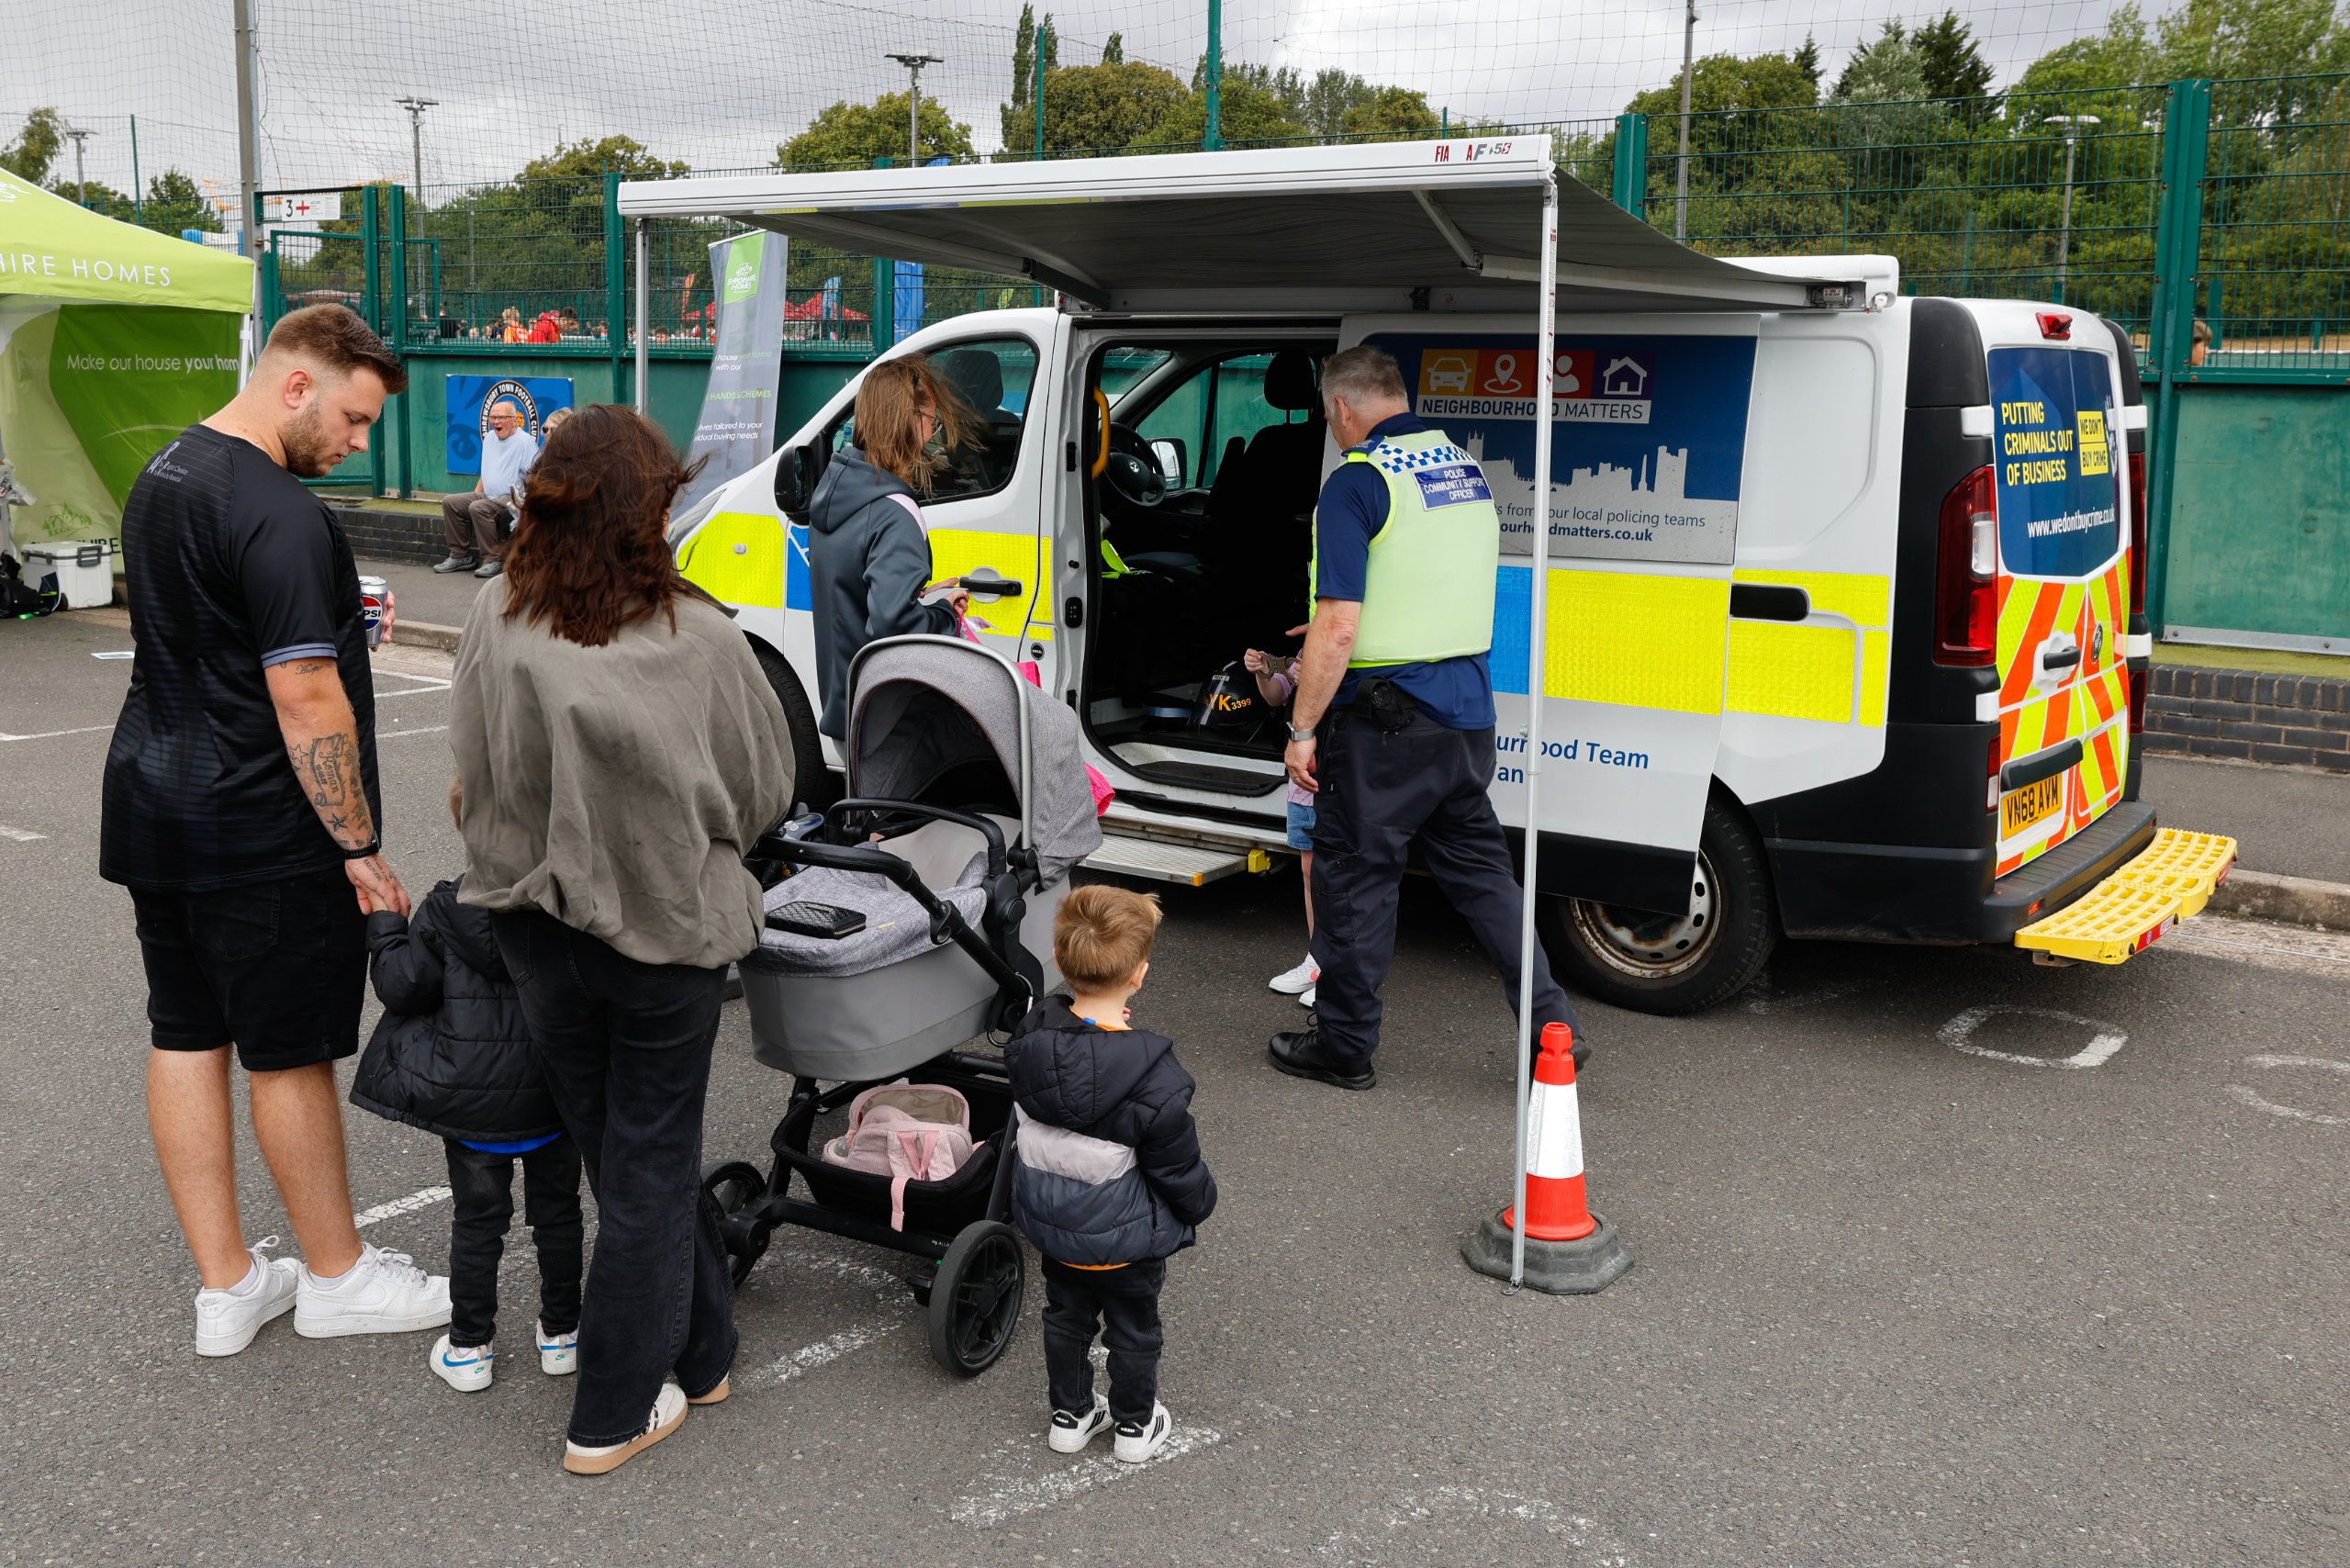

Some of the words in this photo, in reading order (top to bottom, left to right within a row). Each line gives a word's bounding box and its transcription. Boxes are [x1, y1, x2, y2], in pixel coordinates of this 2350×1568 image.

[286, 199, 293, 218] 3
[73, 258, 172, 287] HOMES
[67, 354, 105, 371] Make
[109, 358, 131, 371] our
[136, 354, 181, 371] house
[185, 356, 214, 374] your
[214, 354, 239, 371] hom
[710, 392, 735, 400] HANDS
[737, 389, 771, 398] SCHEMES
[482, 389, 498, 438] SHREWSBURY
[498, 384, 514, 394] TOWN
[514, 386, 535, 419] FOOTBALL
[1422, 399, 1559, 417] NEIGHBOURHOD
[1564, 403, 1643, 420] MATTERS
[2001, 402, 2044, 425] PUTTING
[713, 432, 735, 441] buying
[2079, 419, 2089, 435] WE
[2088, 419, 2102, 434] DON'T
[2004, 431, 2056, 455] CRIMINALS
[2057, 430, 2074, 452] OUT
[2082, 452, 2093, 467] BUY
[2093, 450, 2107, 466] CRIME
[1443, 468, 1467, 479] POLICE
[2007, 464, 2020, 487] OF
[2022, 459, 2066, 485] BUSINESS
[1424, 478, 1462, 494] COMMUNITY
[1463, 477, 1485, 487] SUPPORT
[1449, 489, 1475, 500] OFFICER
[1549, 508, 1569, 519] our
[1572, 507, 1602, 521] local
[1606, 510, 1660, 527] policing
[1664, 513, 1706, 527] teams
[2027, 503, 2115, 538] www.wedontbuycrime.co.uk
[1231, 698, 1251, 710] 3399
[1585, 742, 1649, 769] Team
[2007, 787, 2034, 829] VN68
[2039, 775, 2058, 813] AVM
